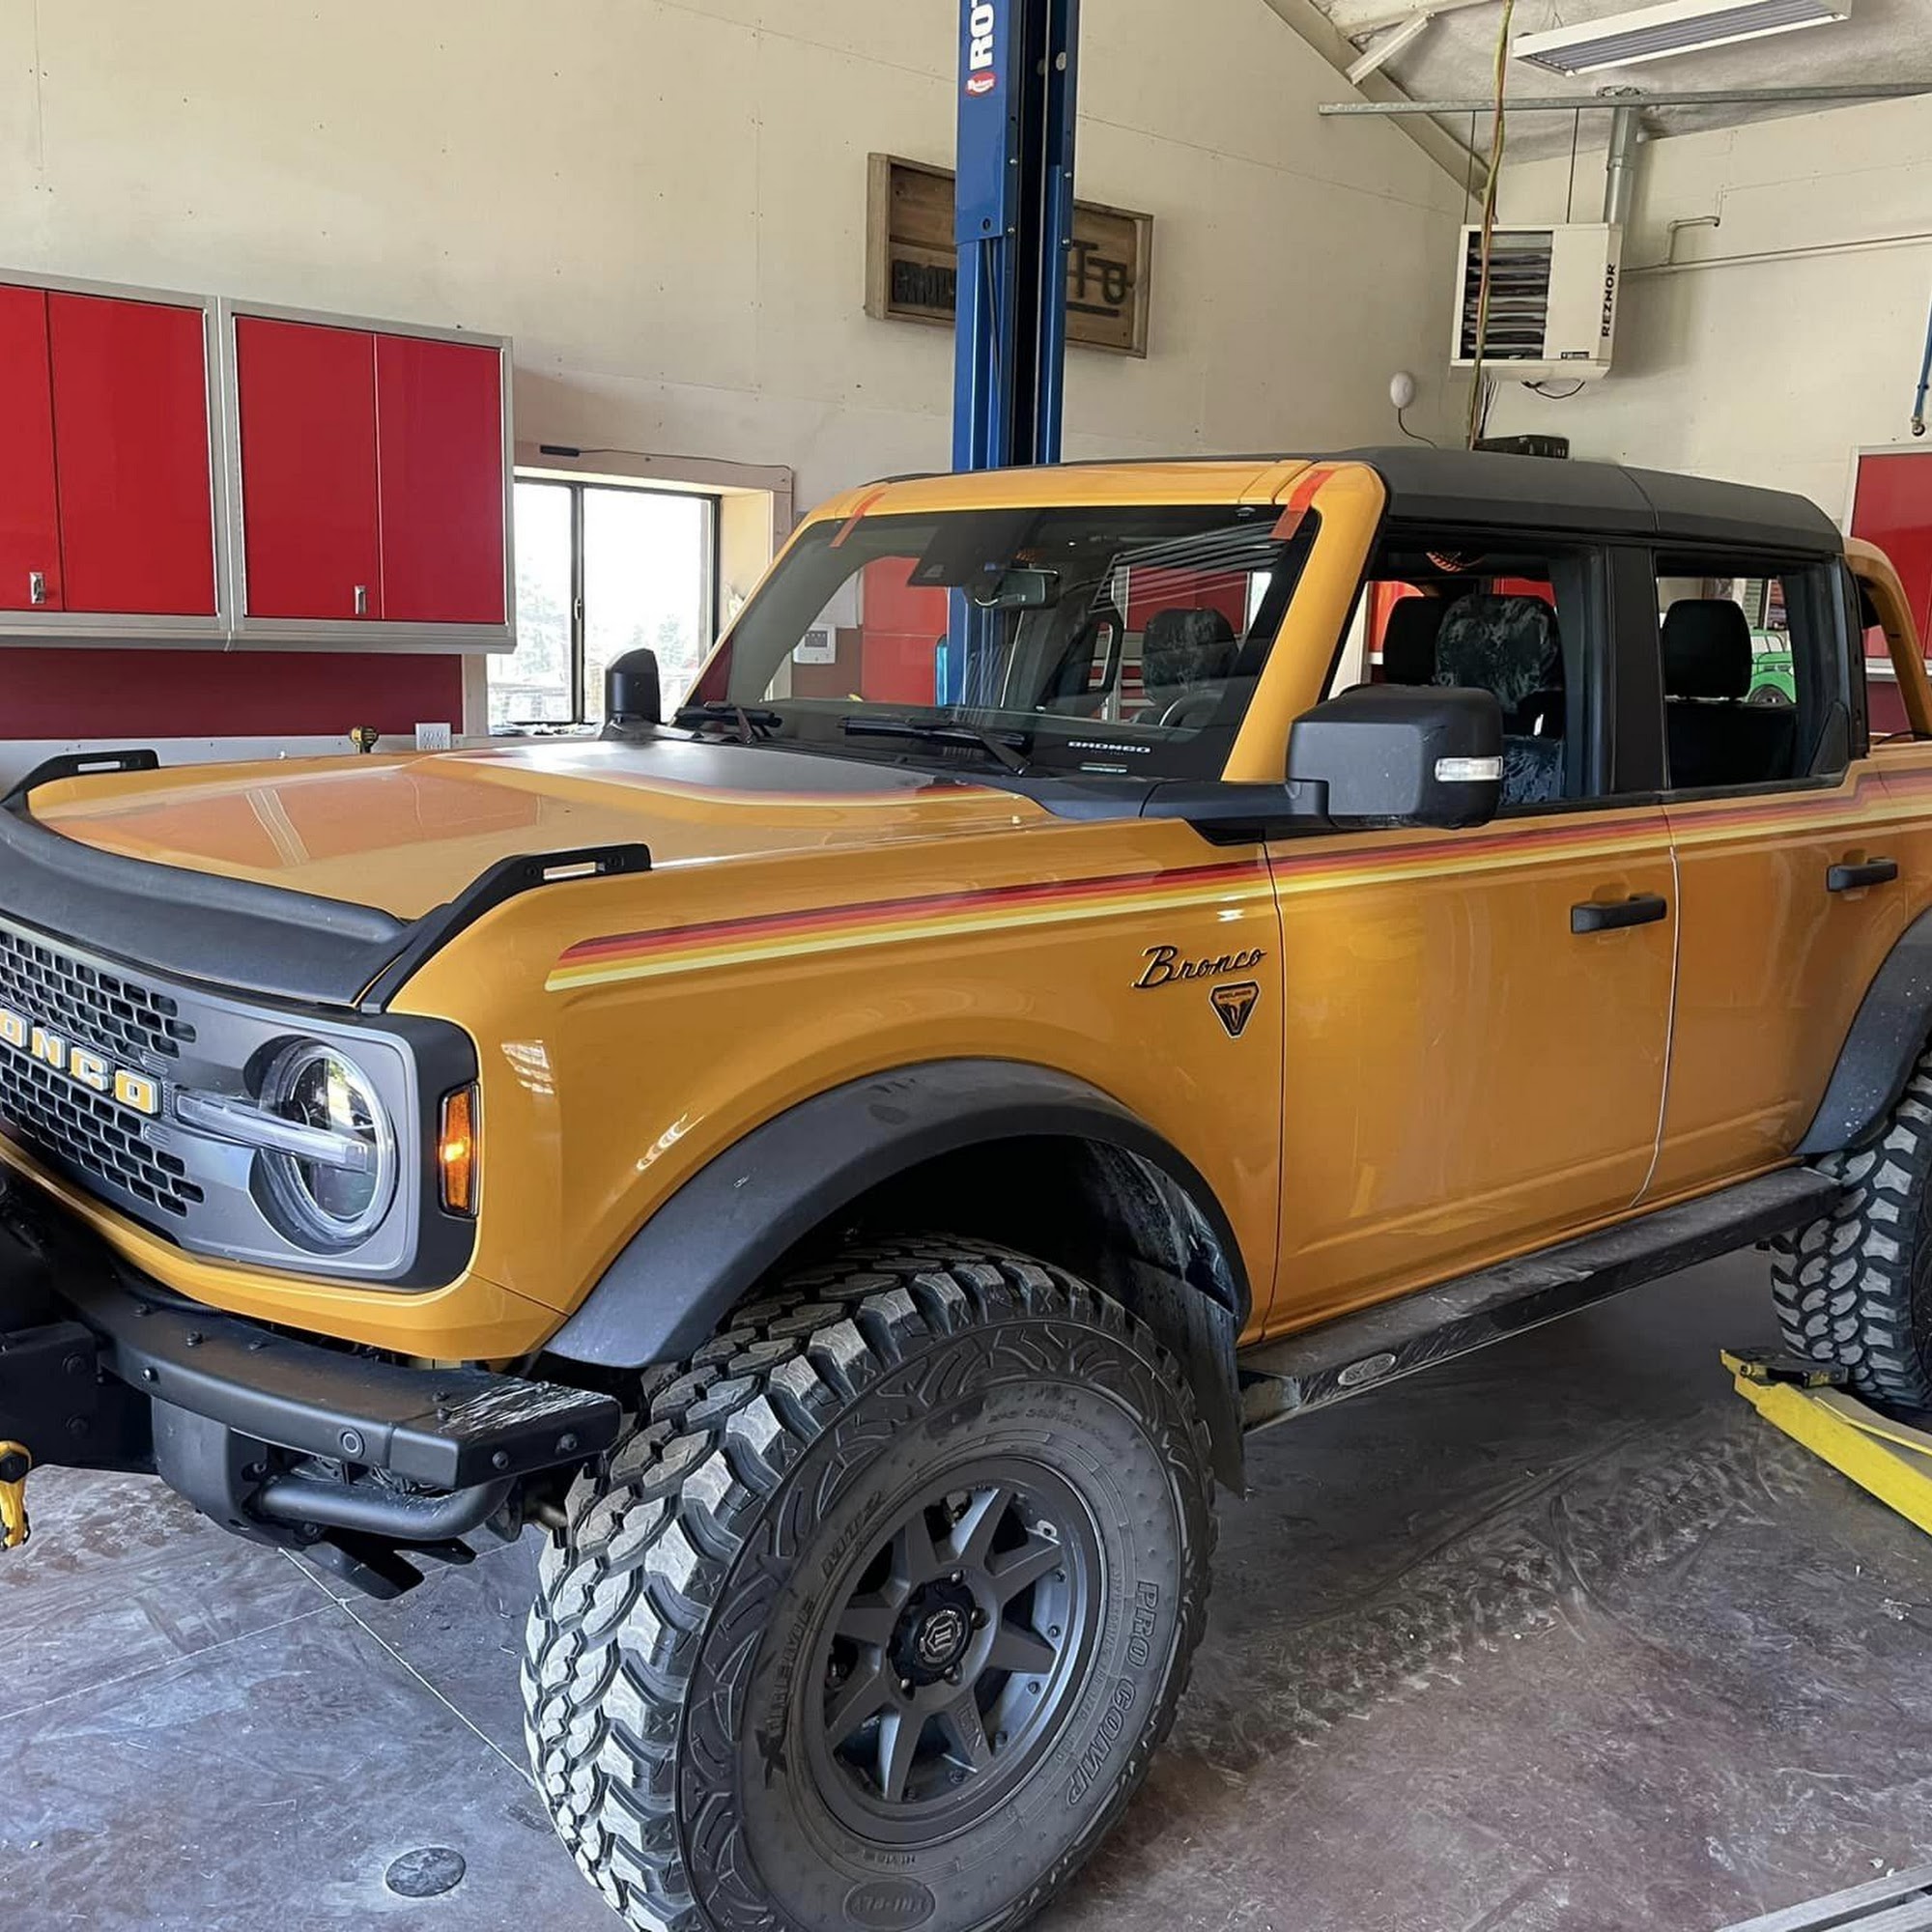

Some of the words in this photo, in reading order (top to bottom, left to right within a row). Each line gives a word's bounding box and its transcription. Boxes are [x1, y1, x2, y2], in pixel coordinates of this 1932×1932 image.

[1601, 264, 1616, 337] REZNOR
[1131, 945, 1268, 988] Bronco
[1126, 1580, 1159, 1667] PRO
[1065, 1678, 1137, 1806] COMP
